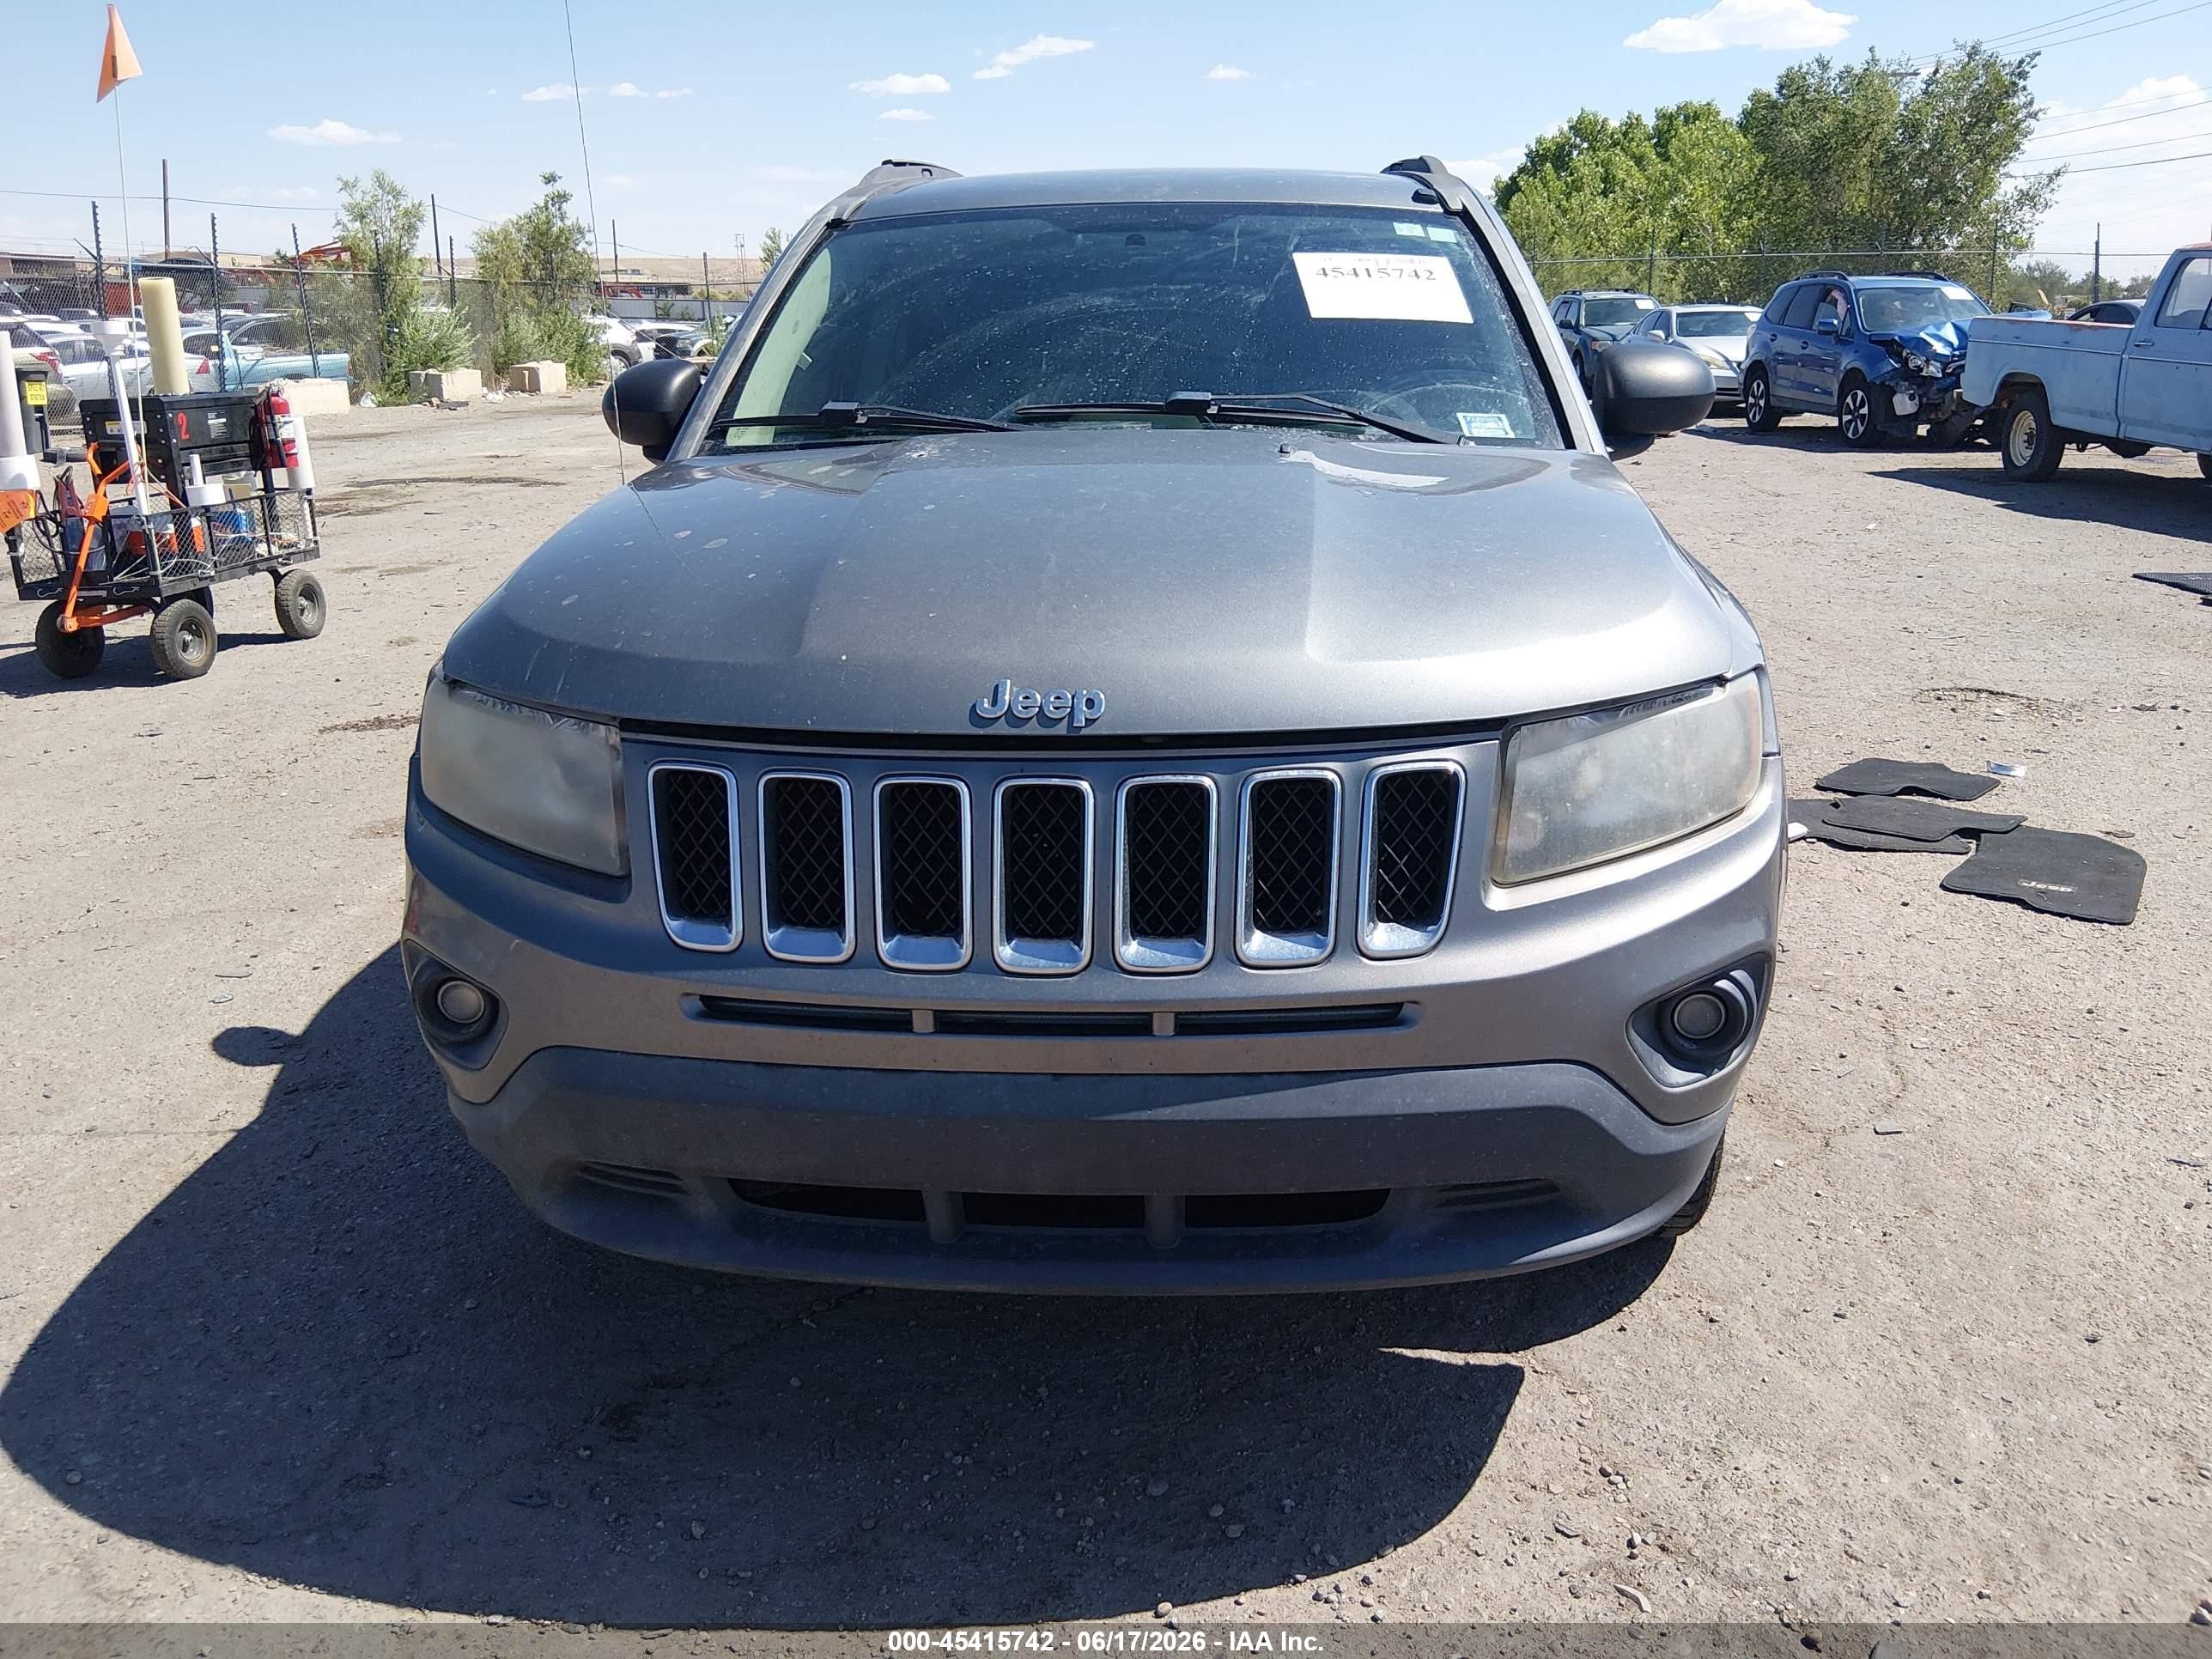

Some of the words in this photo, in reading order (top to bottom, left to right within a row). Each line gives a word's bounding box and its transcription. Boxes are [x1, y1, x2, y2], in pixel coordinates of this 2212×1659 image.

[1316, 267, 1437, 281] 45415742
[177, 411, 190, 440] 2
[975, 678, 1106, 727] Jeep
